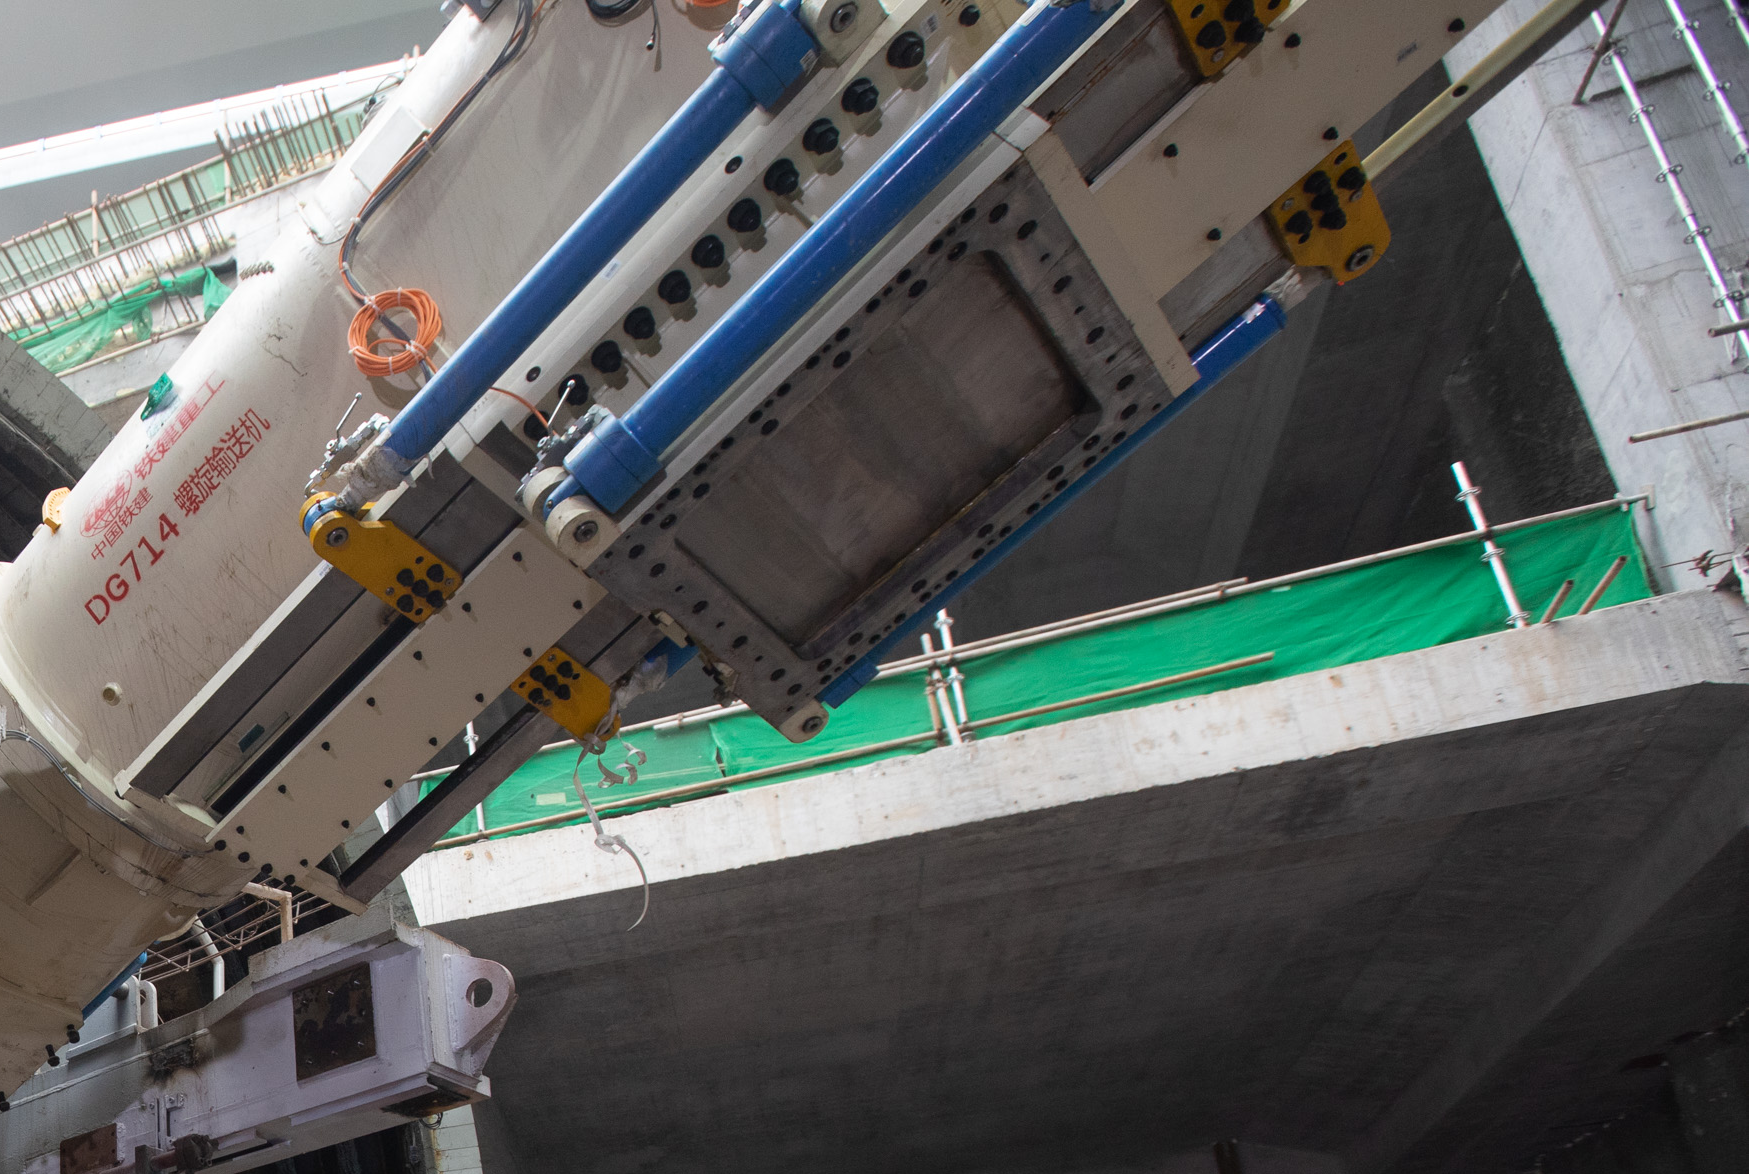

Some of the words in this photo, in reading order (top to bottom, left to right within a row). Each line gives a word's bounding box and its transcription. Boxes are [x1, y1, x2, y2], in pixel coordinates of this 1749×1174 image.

[84, 513, 180, 625] DG714
[173, 408, 271, 517] 螺旋输送机
[91, 487, 153, 560] 中国铁建
